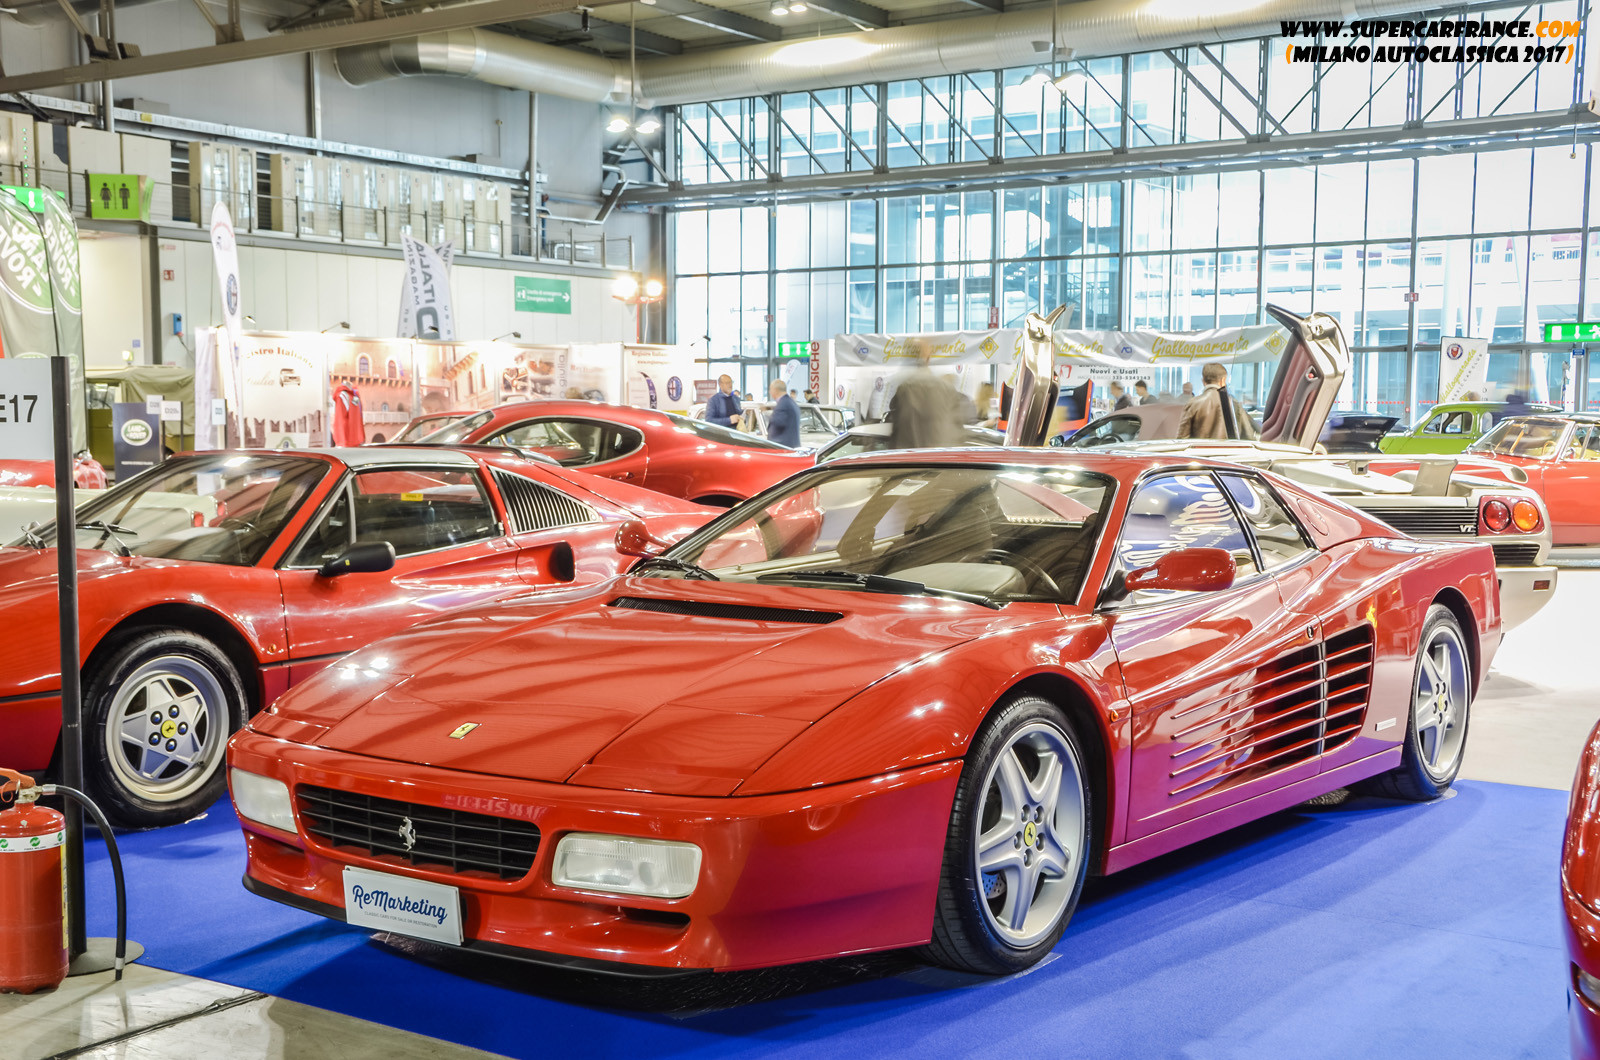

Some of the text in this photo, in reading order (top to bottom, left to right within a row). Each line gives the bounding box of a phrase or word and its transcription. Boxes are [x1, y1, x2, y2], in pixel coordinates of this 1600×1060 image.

[1148, 335, 1249, 362] Gialloquaranta
[1460, 524, 1475, 532] VT
[352, 885, 447, 925] ReMarketing
